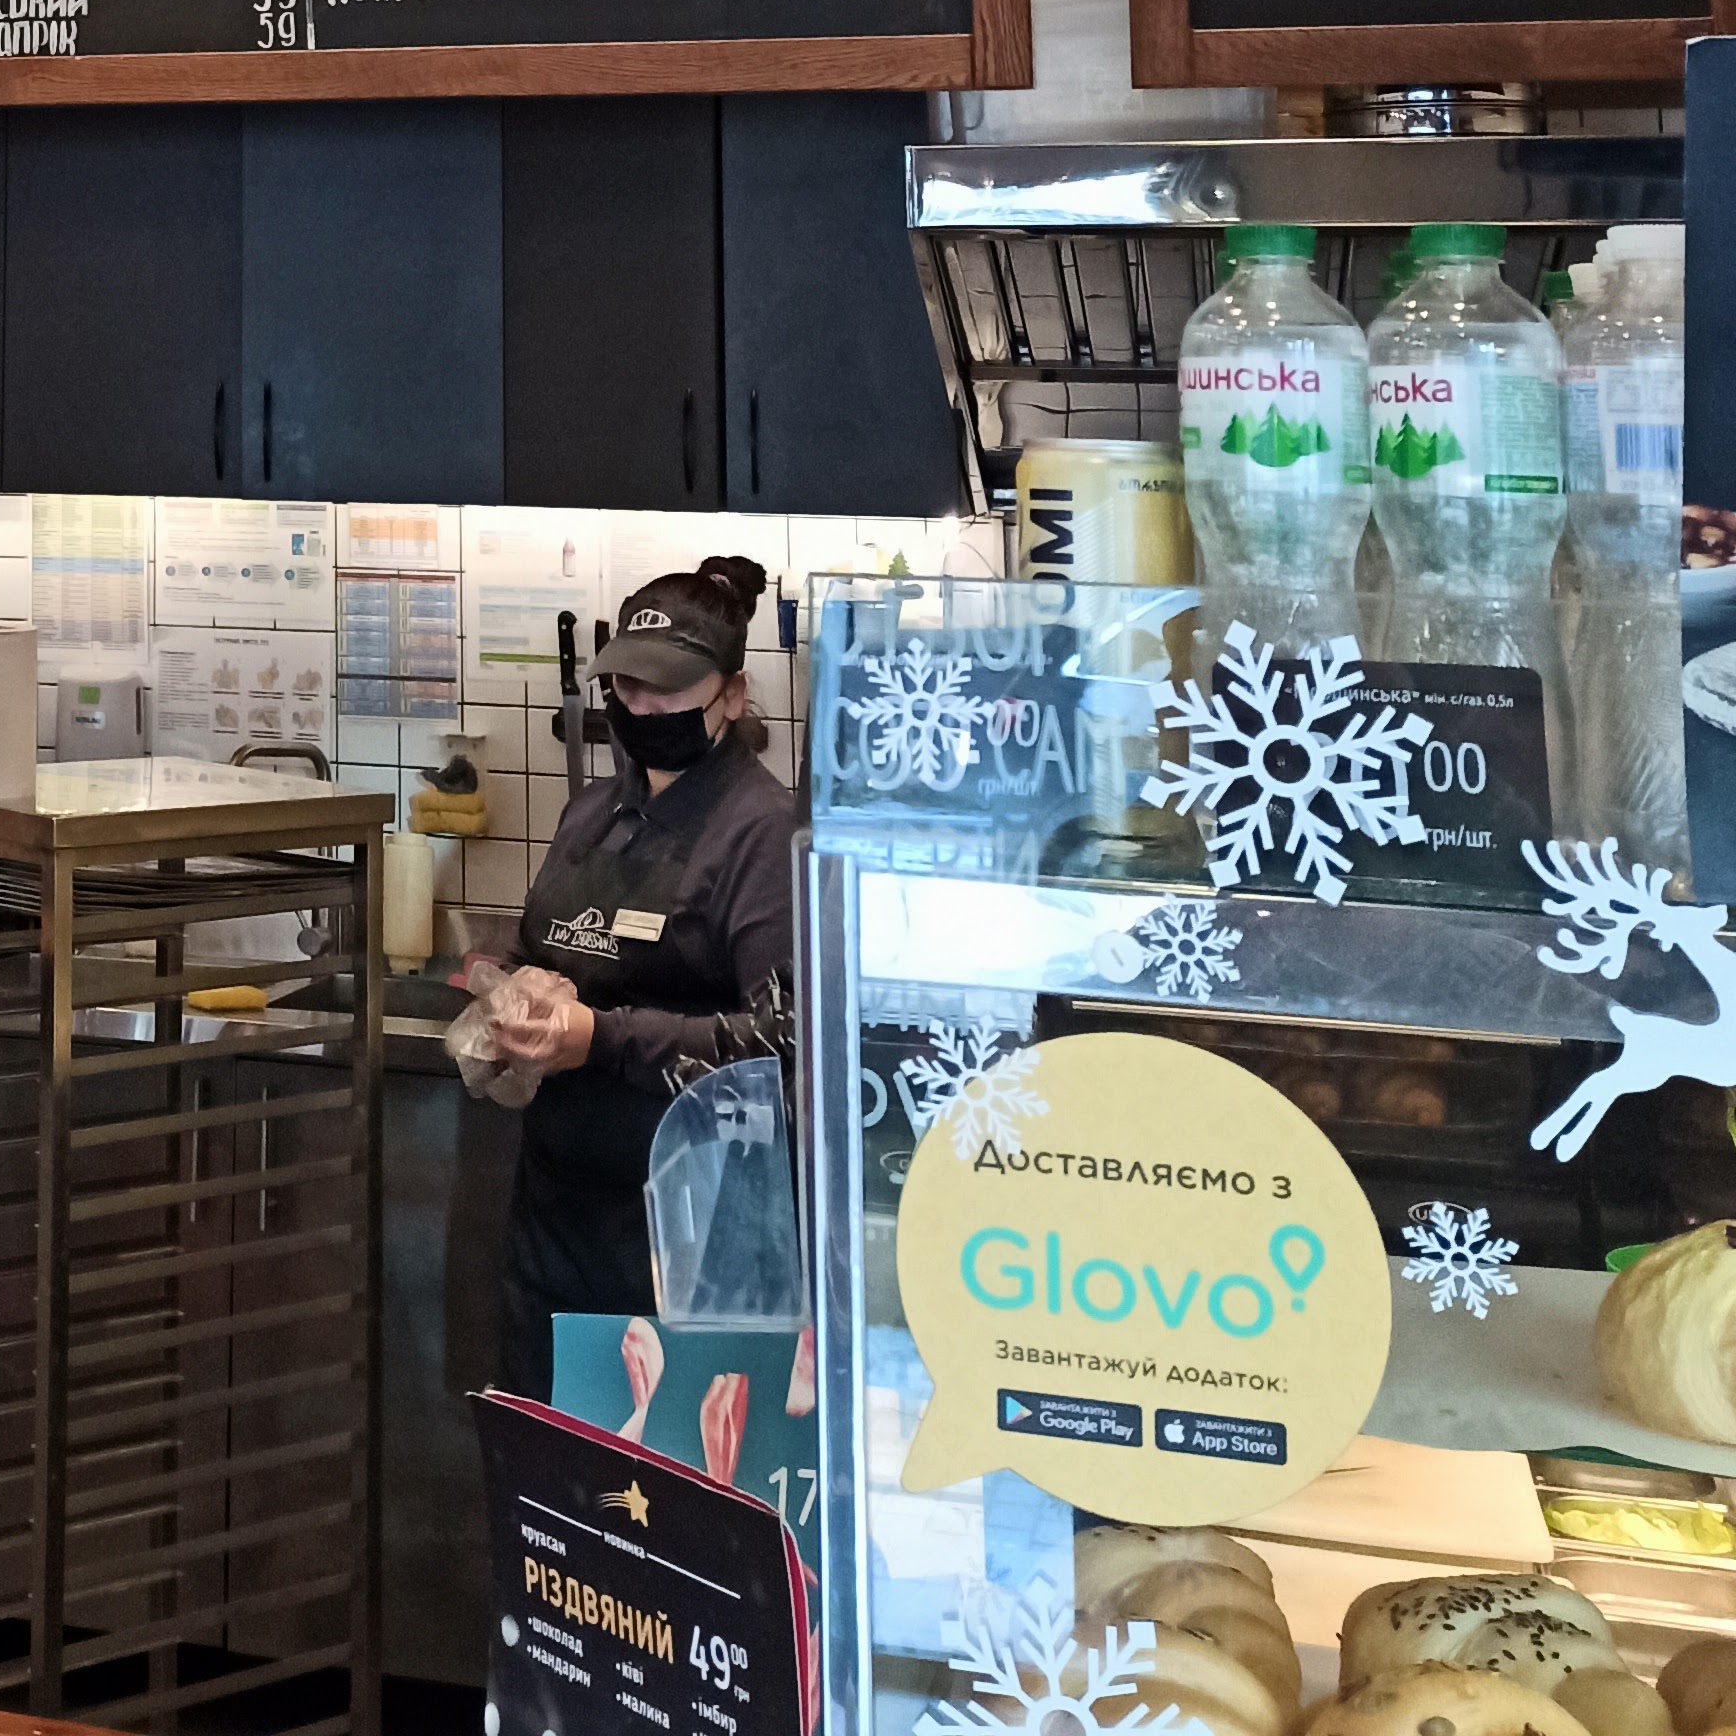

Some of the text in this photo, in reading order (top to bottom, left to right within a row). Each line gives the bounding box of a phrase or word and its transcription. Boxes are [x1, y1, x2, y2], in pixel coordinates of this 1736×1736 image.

[973, 1139, 1256, 1195] Доставляємо
[959, 1225, 1274, 1340] Glovo
[995, 1339, 1157, 1379] Завантажуй
[1040, 1411, 1133, 1441] Google Play
[1192, 1431, 1277, 1456] App Store
[521, 1523, 566, 1557] круасан
[524, 1555, 674, 1665] РІЗДВЯНИЙ
[532, 1616, 584, 1658] шоколад
[689, 1625, 730, 1690] 49
[532, 1645, 591, 1687] мандарин
[622, 1691, 670, 1730] малина
